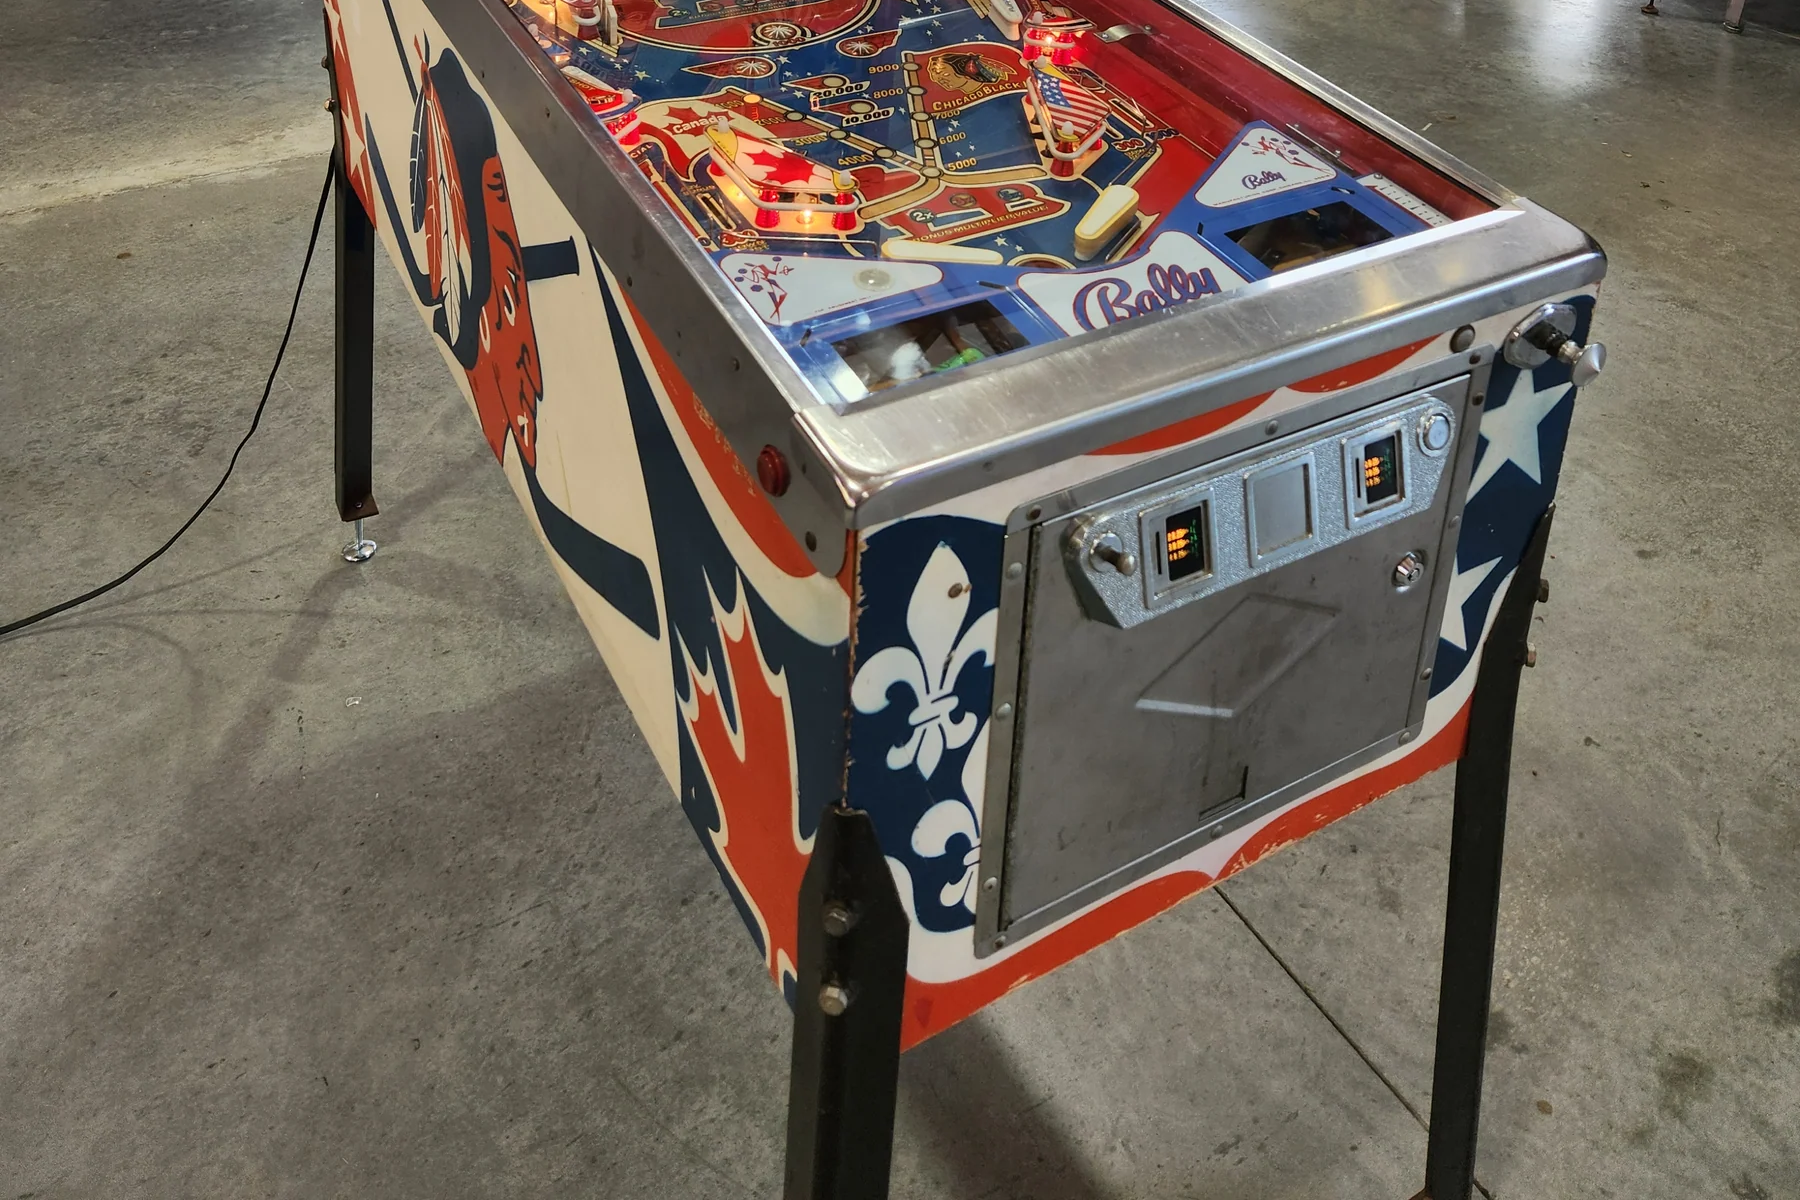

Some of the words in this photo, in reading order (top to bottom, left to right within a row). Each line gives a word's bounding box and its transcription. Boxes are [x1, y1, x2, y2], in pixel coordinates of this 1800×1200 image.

[868, 63, 900, 74] 9000
[813, 83, 864, 98] 20,000
[873, 87, 904, 99] 8000
[932, 90, 984, 111] CHICAGO
[982, 81, 1022, 95] BLACK
[935, 109, 961, 120] 7000
[672, 112, 730, 134] Canada
[792, 134, 828, 146] 3000
[939, 132, 967, 145] 6000
[1112, 138, 1145, 151] 300
[837, 154, 875, 167] 4000
[948, 157, 977, 171] 5000
[1242, 170, 1286, 190] Bally
[1073, 263, 1222, 327] Bally
